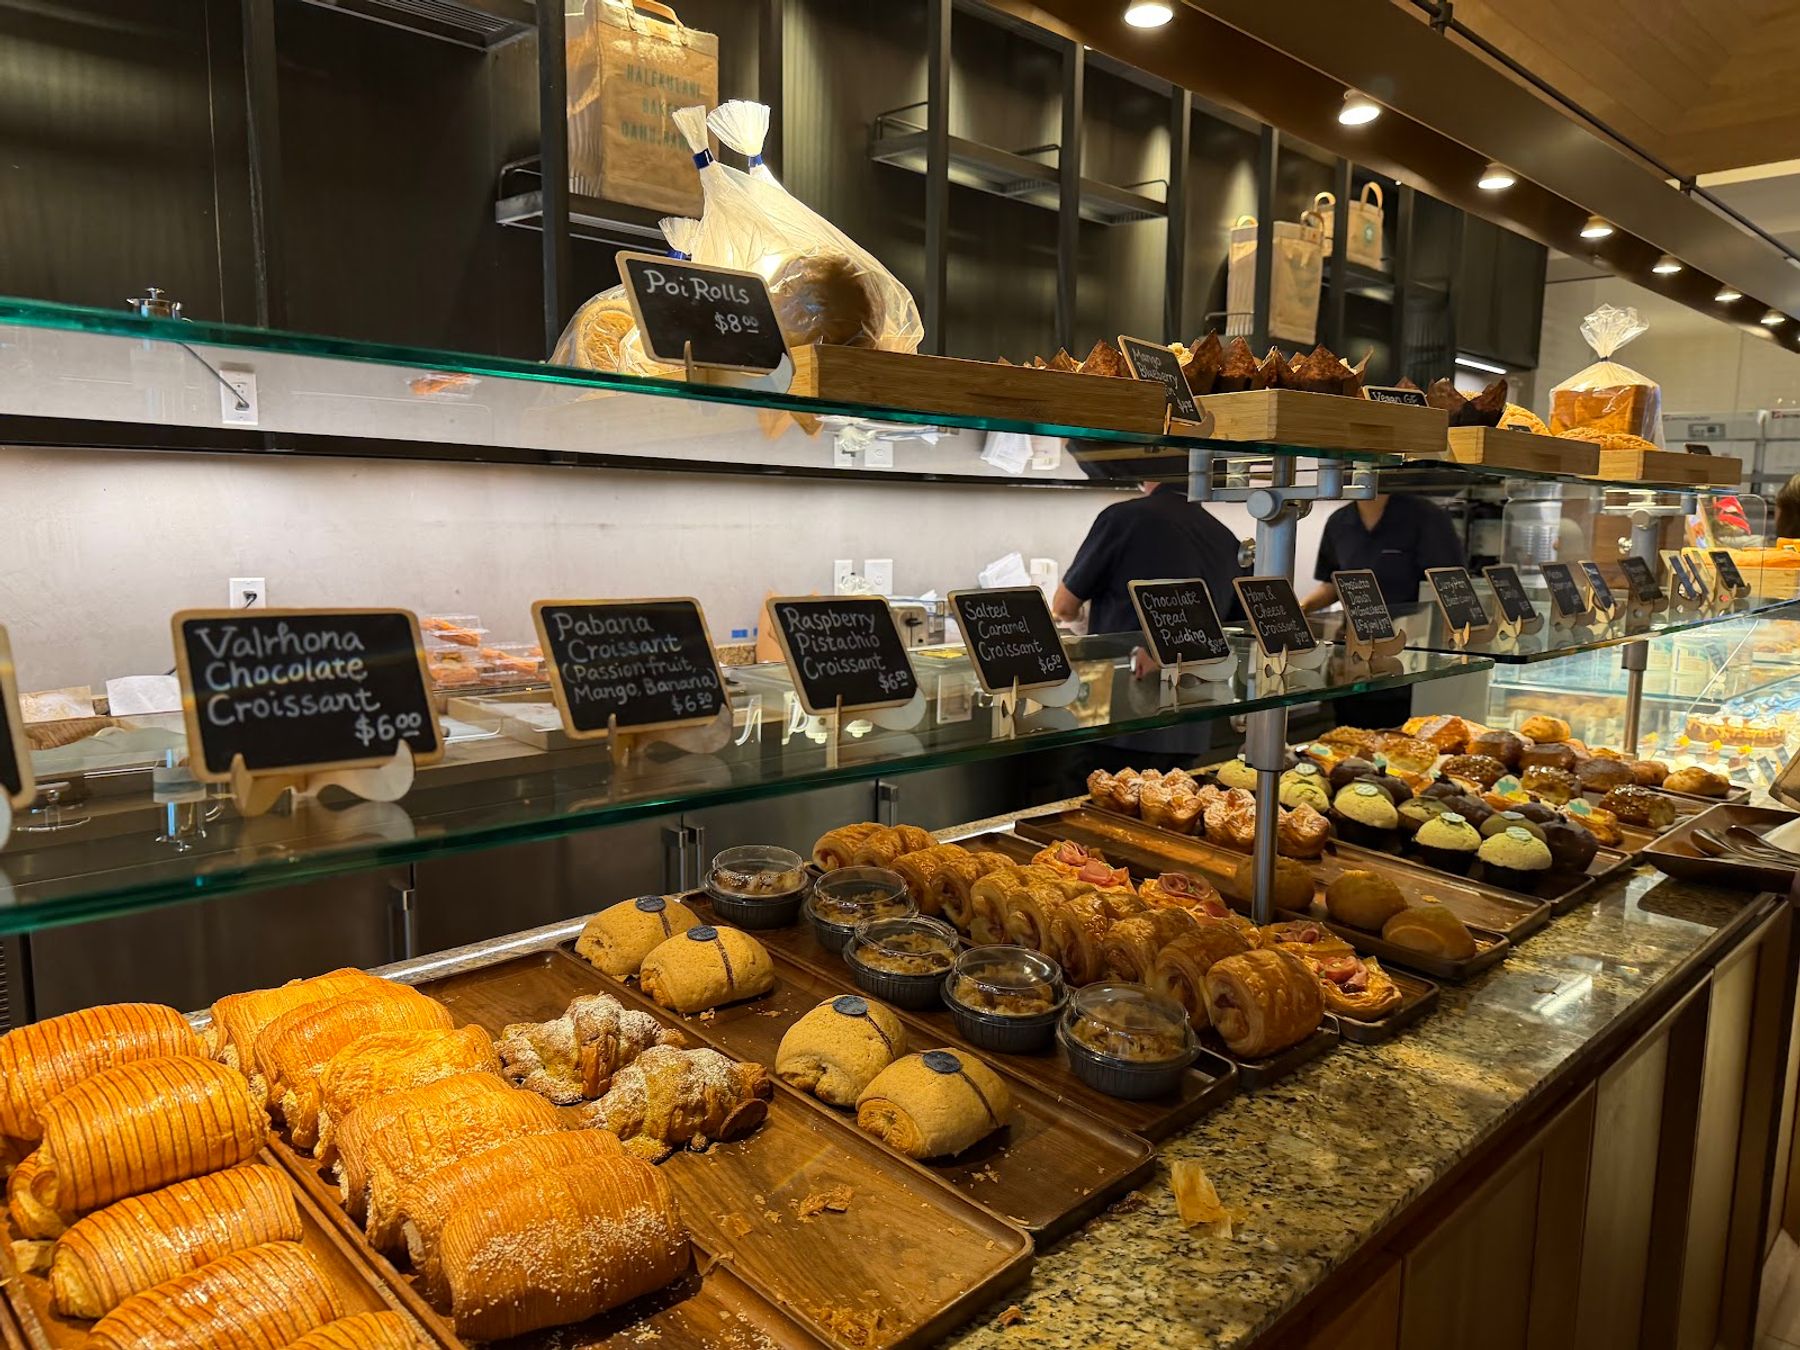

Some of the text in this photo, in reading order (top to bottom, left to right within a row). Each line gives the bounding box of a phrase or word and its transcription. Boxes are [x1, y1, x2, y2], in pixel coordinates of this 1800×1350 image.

[627, 63, 701, 98] HALEKULANI
[643, 269, 750, 304] Poi Rolls
[1132, 348, 1161, 368] Mango
[1142, 590, 1200, 610] Chocolate
[1242, 585, 1277, 602] Ham &
[783, 607, 875, 635] Raspberry
[965, 600, 1010, 620] Salted
[1150, 609, 1188, 627] Bread
[1253, 603, 1287, 618] Cheese
[553, 612, 654, 642] Pabana
[978, 615, 1030, 639] Caramel
[1160, 627, 1207, 646] Pudding
[1259, 617, 1300, 636] Croissant
[197, 622, 365, 659] Valrhona
[567, 634, 682, 663] Croissant
[796, 631, 880, 655] Pistachio
[978, 640, 1042, 661] Croissant
[205, 656, 368, 692] Chocolate
[803, 653, 886, 680] Croissant
[645, 668, 719, 696] Banana)
[207, 690, 380, 727] Croissant
